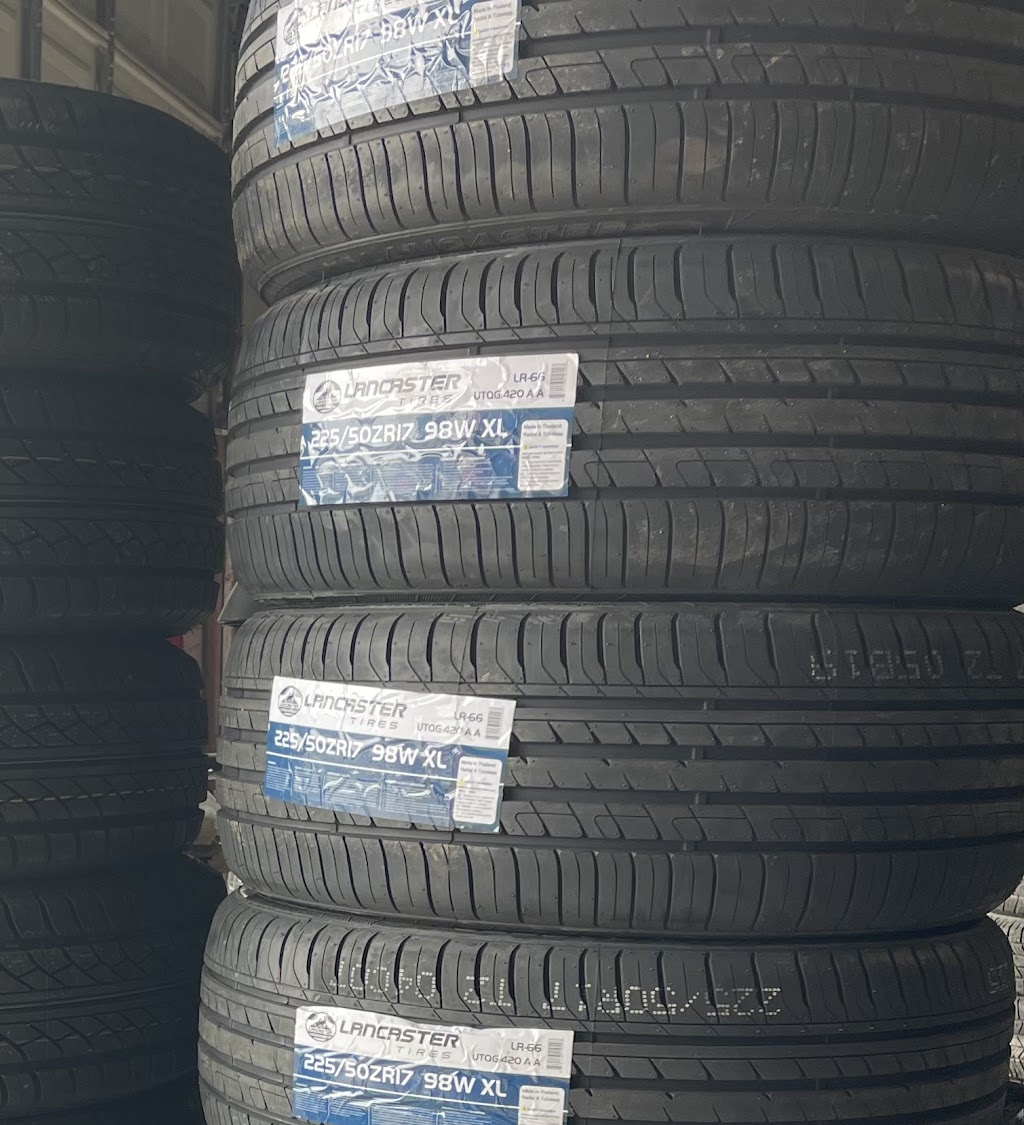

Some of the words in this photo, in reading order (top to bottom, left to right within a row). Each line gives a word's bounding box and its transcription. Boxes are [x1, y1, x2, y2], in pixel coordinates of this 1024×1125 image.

[344, 374, 462, 398] LANCASTER
[513, 372, 546, 383] LR-66
[399, 393, 453, 406] TIRES
[312, 424, 414, 448] 225/50ZR17
[425, 419, 475, 440] 98W
[481, 418, 508, 439] XL
[304, 694, 408, 718] LANCASTER
[454, 711, 484, 723] LR-66
[350, 716, 399, 730] TIRES
[274, 730, 363, 759] 225/50ZR17
[371, 744, 419, 766] 98W
[422, 751, 448, 769] XL
[340, 1021, 460, 1048] LANCASTER
[511, 1042, 542, 1053] LR-66
[397, 1046, 452, 1059] TIRES
[533, 1059, 541, 1067] A
[304, 1054, 414, 1086] 225/50ZR17
[424, 1072, 475, 1094] 98W
[481, 1079, 508, 1097] XL
